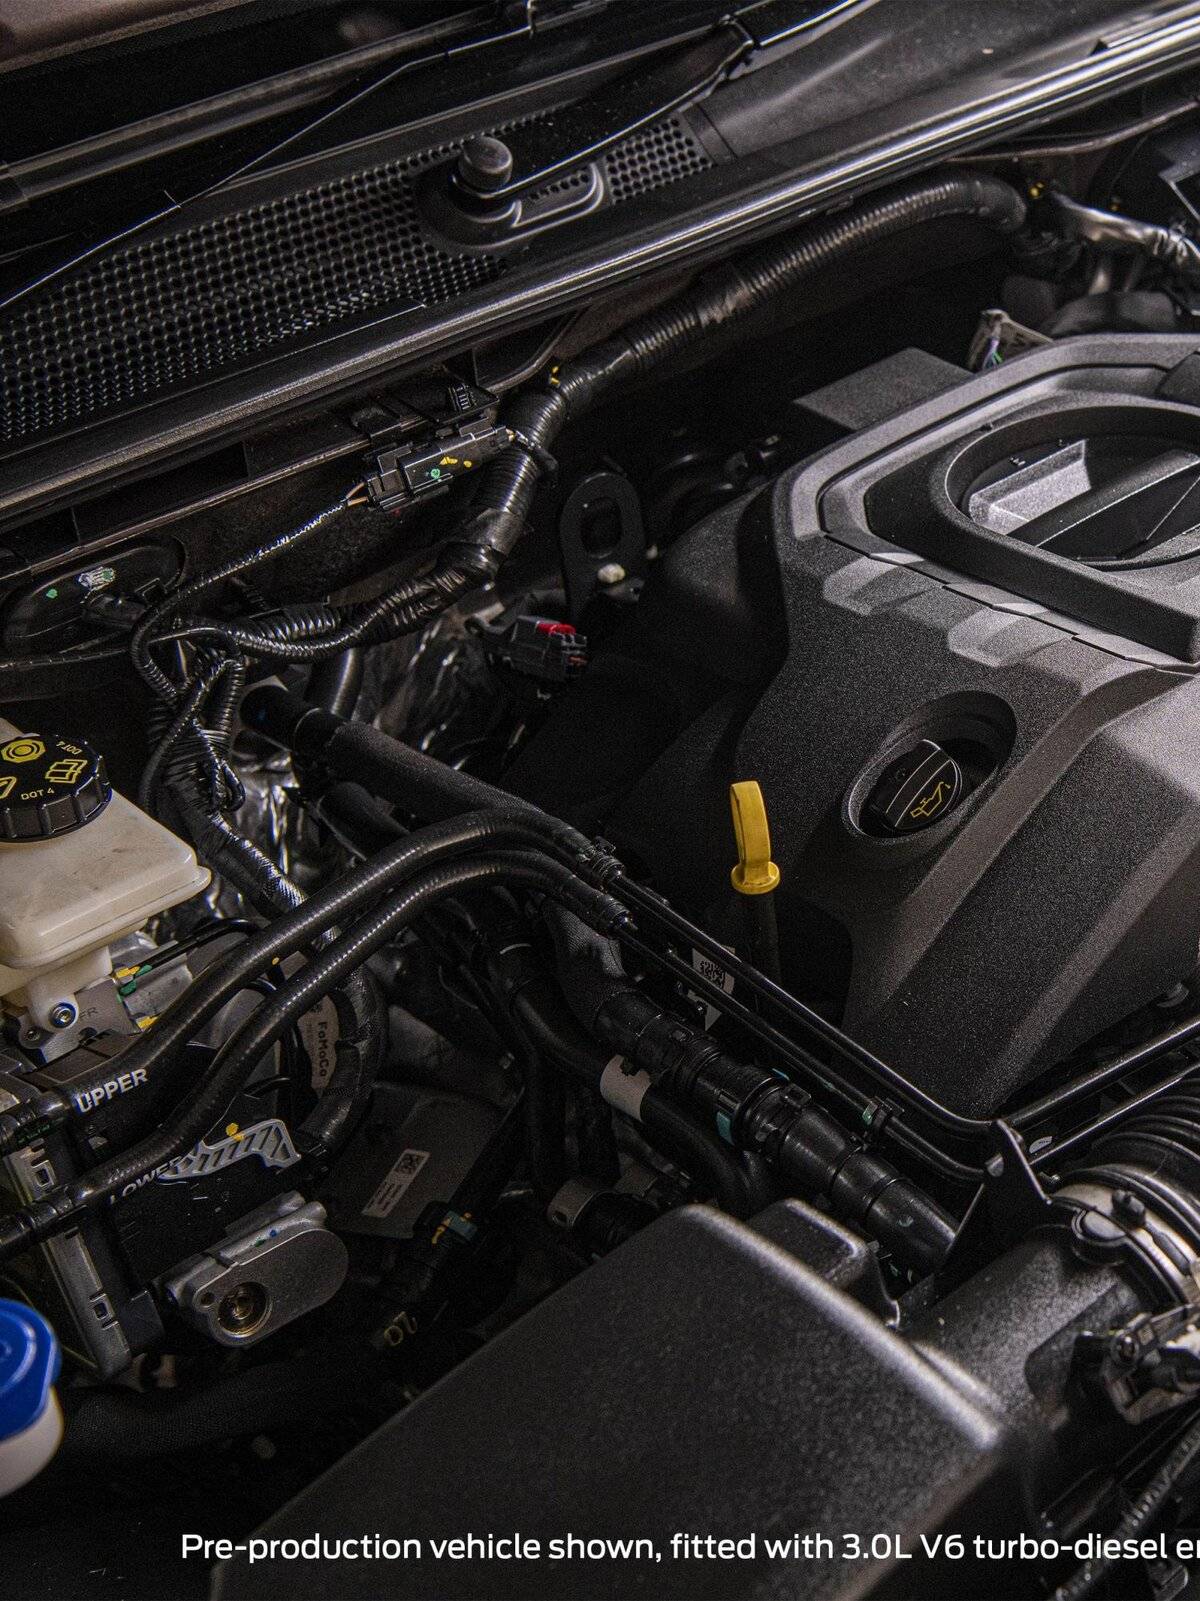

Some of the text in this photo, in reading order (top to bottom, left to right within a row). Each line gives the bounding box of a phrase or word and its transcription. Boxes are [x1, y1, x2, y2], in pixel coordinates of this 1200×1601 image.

[21, 789, 44, 800] DOT
[318, 1021, 329, 1077] FoMoCo
[75, 1068, 148, 1113] UPPER
